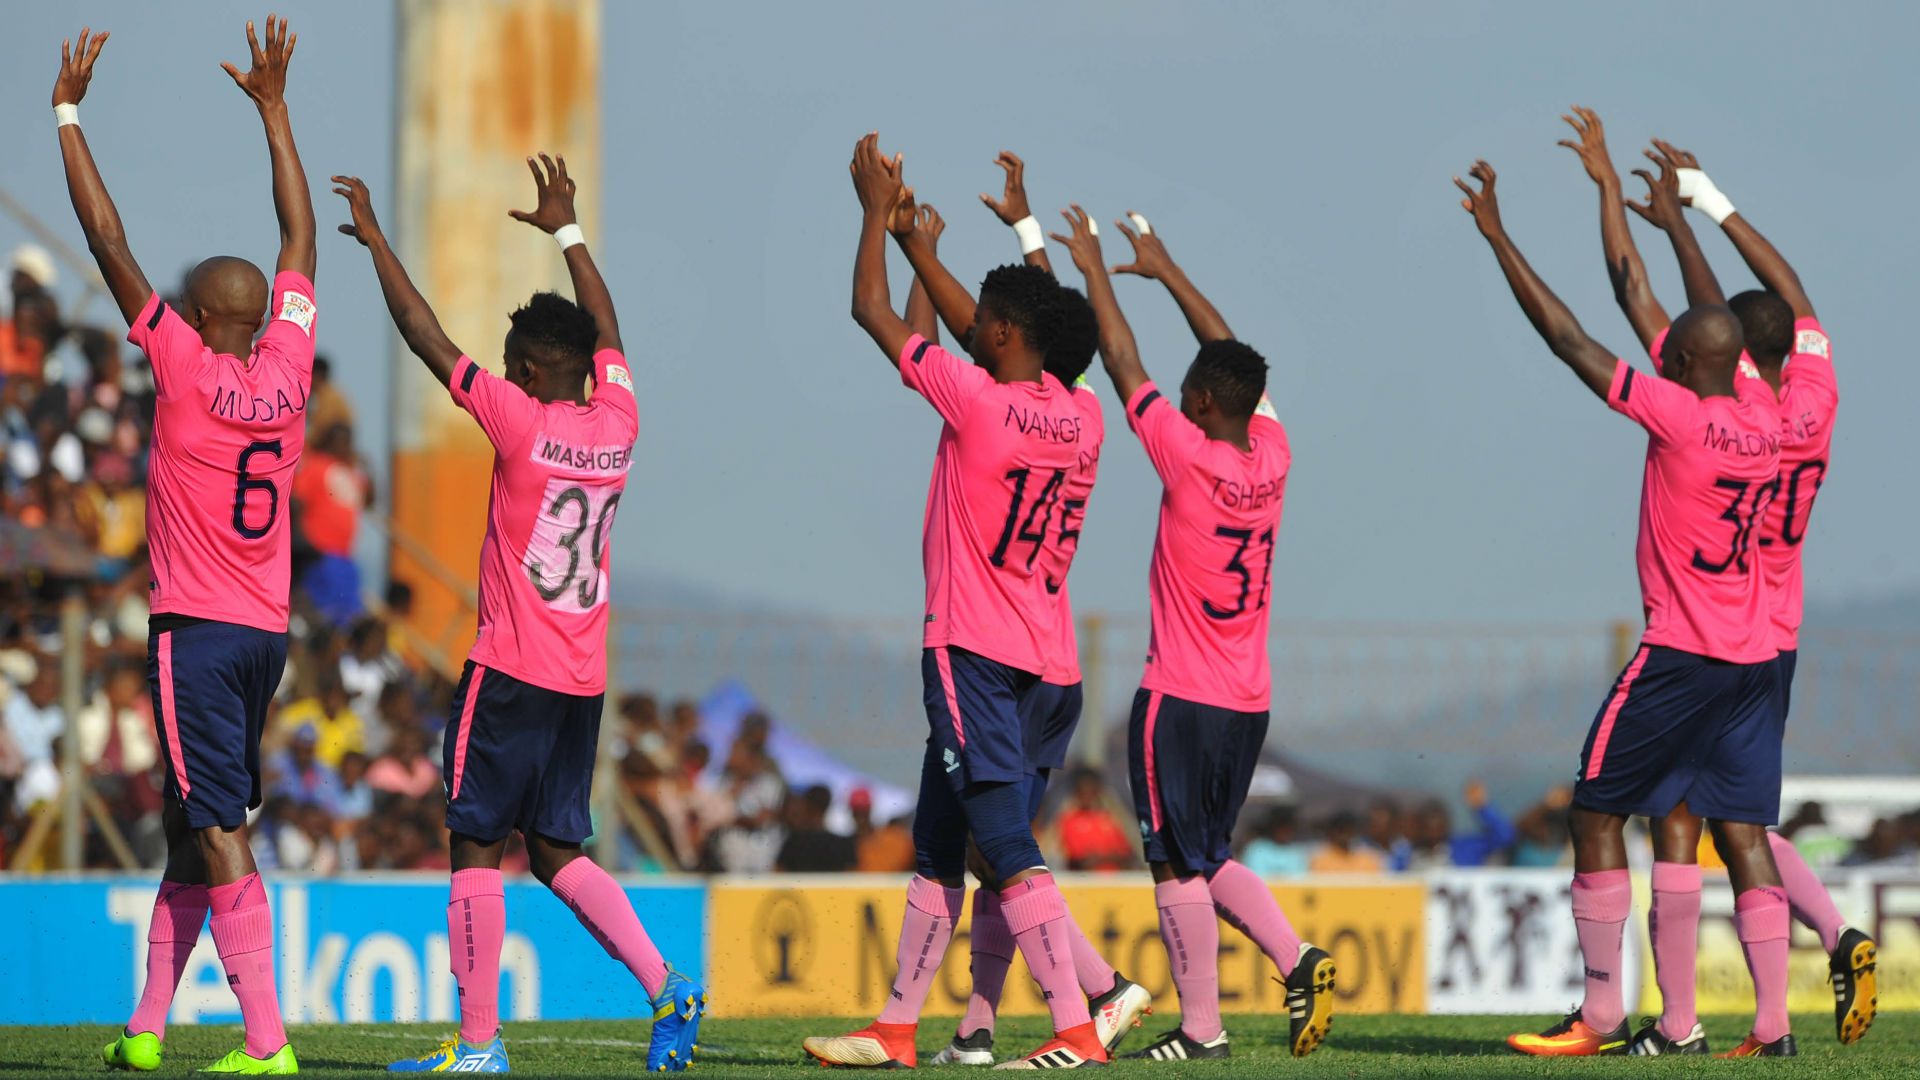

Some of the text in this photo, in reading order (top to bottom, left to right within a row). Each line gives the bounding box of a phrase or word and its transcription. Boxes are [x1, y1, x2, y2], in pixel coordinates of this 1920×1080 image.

[232, 439, 282, 541] 6
[988, 467, 1066, 573] 14
[528, 486, 623, 609] 39
[1202, 523, 1276, 621] 31
